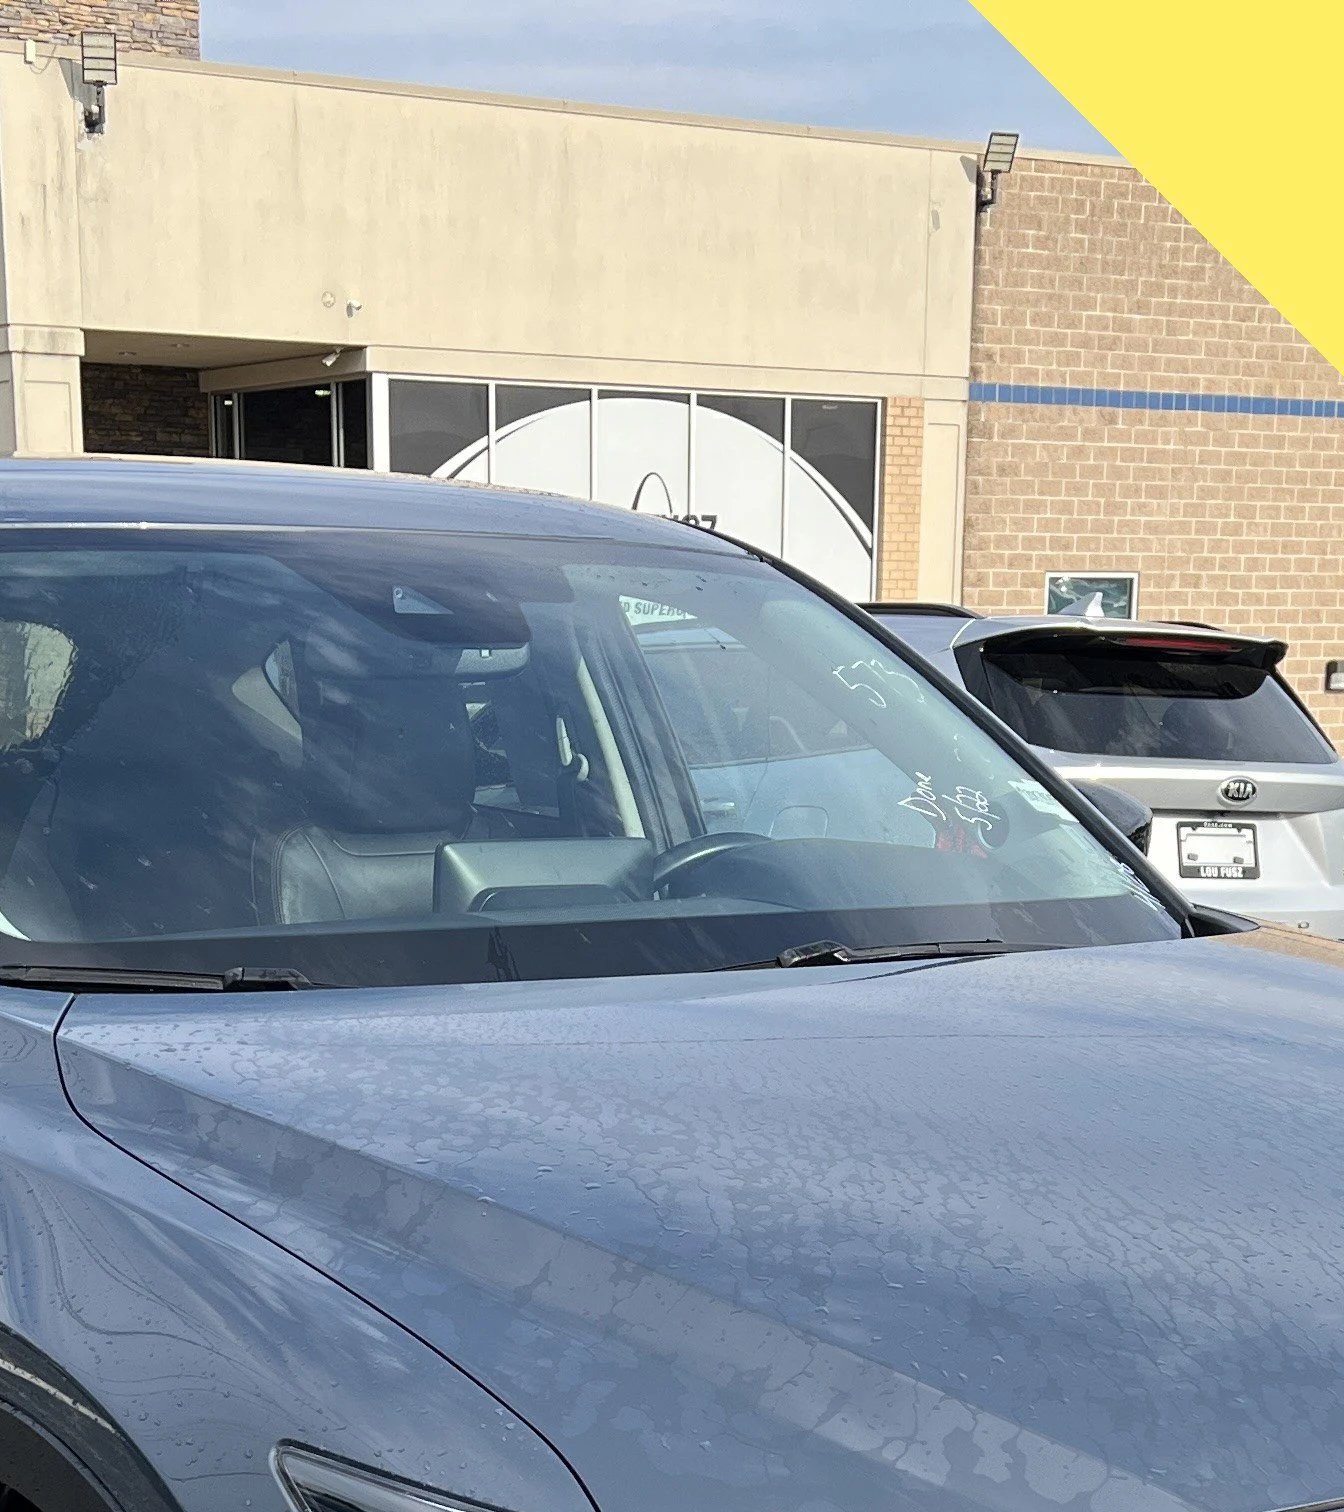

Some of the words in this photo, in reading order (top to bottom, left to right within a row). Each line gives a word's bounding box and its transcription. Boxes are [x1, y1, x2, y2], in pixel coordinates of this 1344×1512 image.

[1227, 782, 1256, 799] KIA
[1200, 866, 1218, 878] LOU
[1220, 866, 1244, 878] FUSZ
